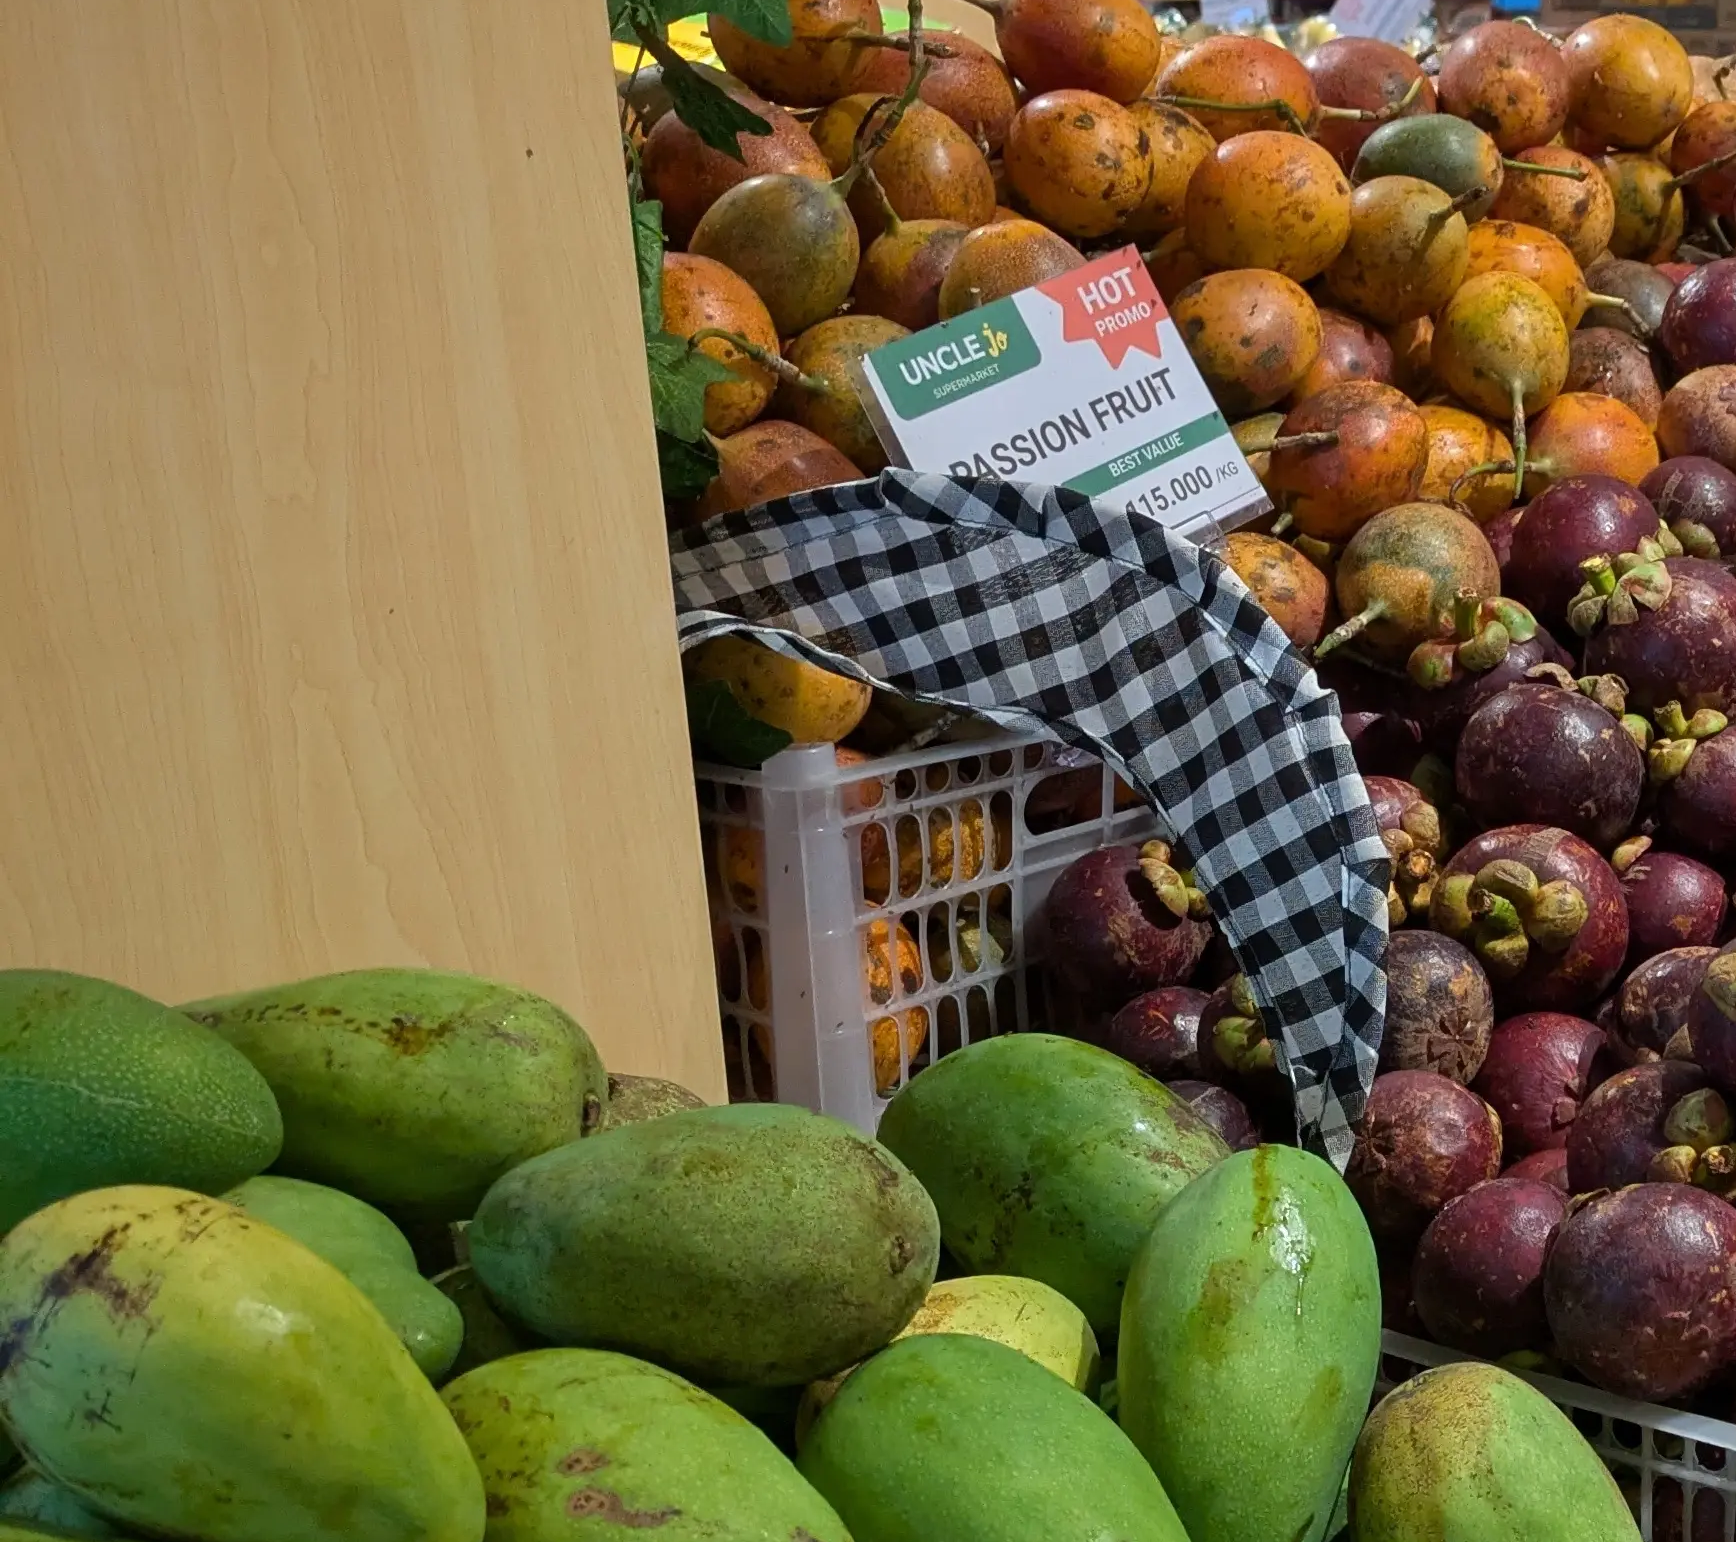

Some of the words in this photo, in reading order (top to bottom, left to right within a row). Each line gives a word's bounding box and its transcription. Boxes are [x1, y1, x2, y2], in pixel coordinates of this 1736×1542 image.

[1078, 267, 1137, 316] HOT
[1093, 301, 1152, 339] PROMO
[898, 333, 987, 387] UNCLE
[932, 363, 1000, 400] SUPERMARKET
[948, 408, 1092, 480] PASSION
[1088, 367, 1178, 432] FRUIT
[1109, 453, 1142, 478] BEST
[1140, 431, 1185, 461] VALUE
